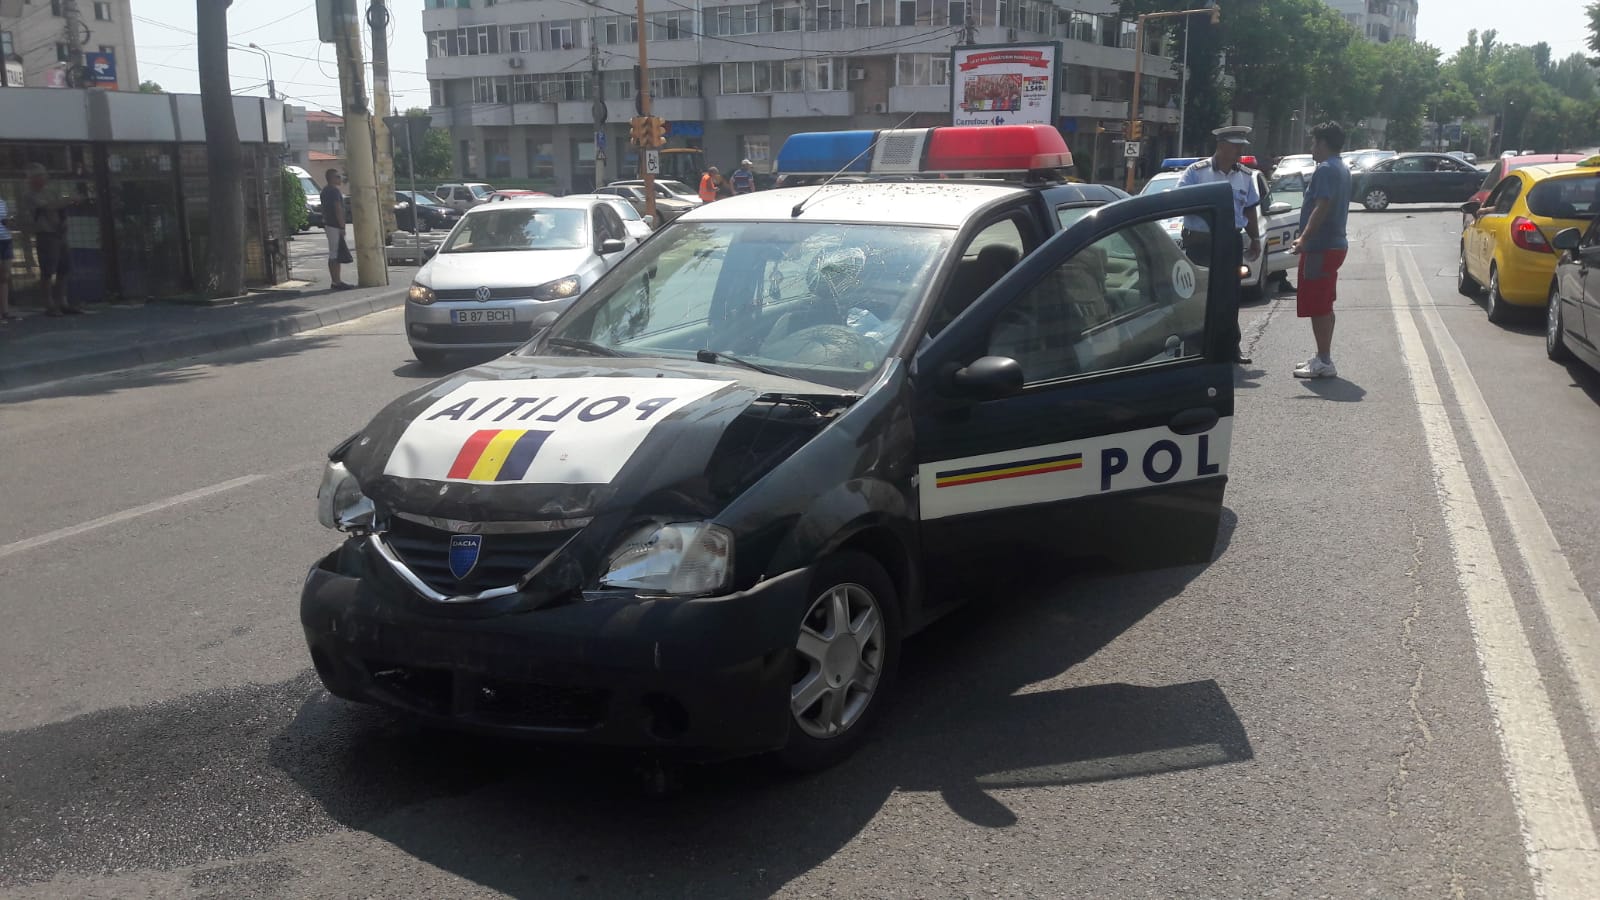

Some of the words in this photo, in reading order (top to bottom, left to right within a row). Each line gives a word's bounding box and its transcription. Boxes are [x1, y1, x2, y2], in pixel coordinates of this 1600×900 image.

[955, 118, 988, 126] Carrefour
[459, 312, 467, 321] B
[470, 311, 483, 321] 87
[487, 310, 511, 321] BCH
[1101, 434, 1219, 491] POL
